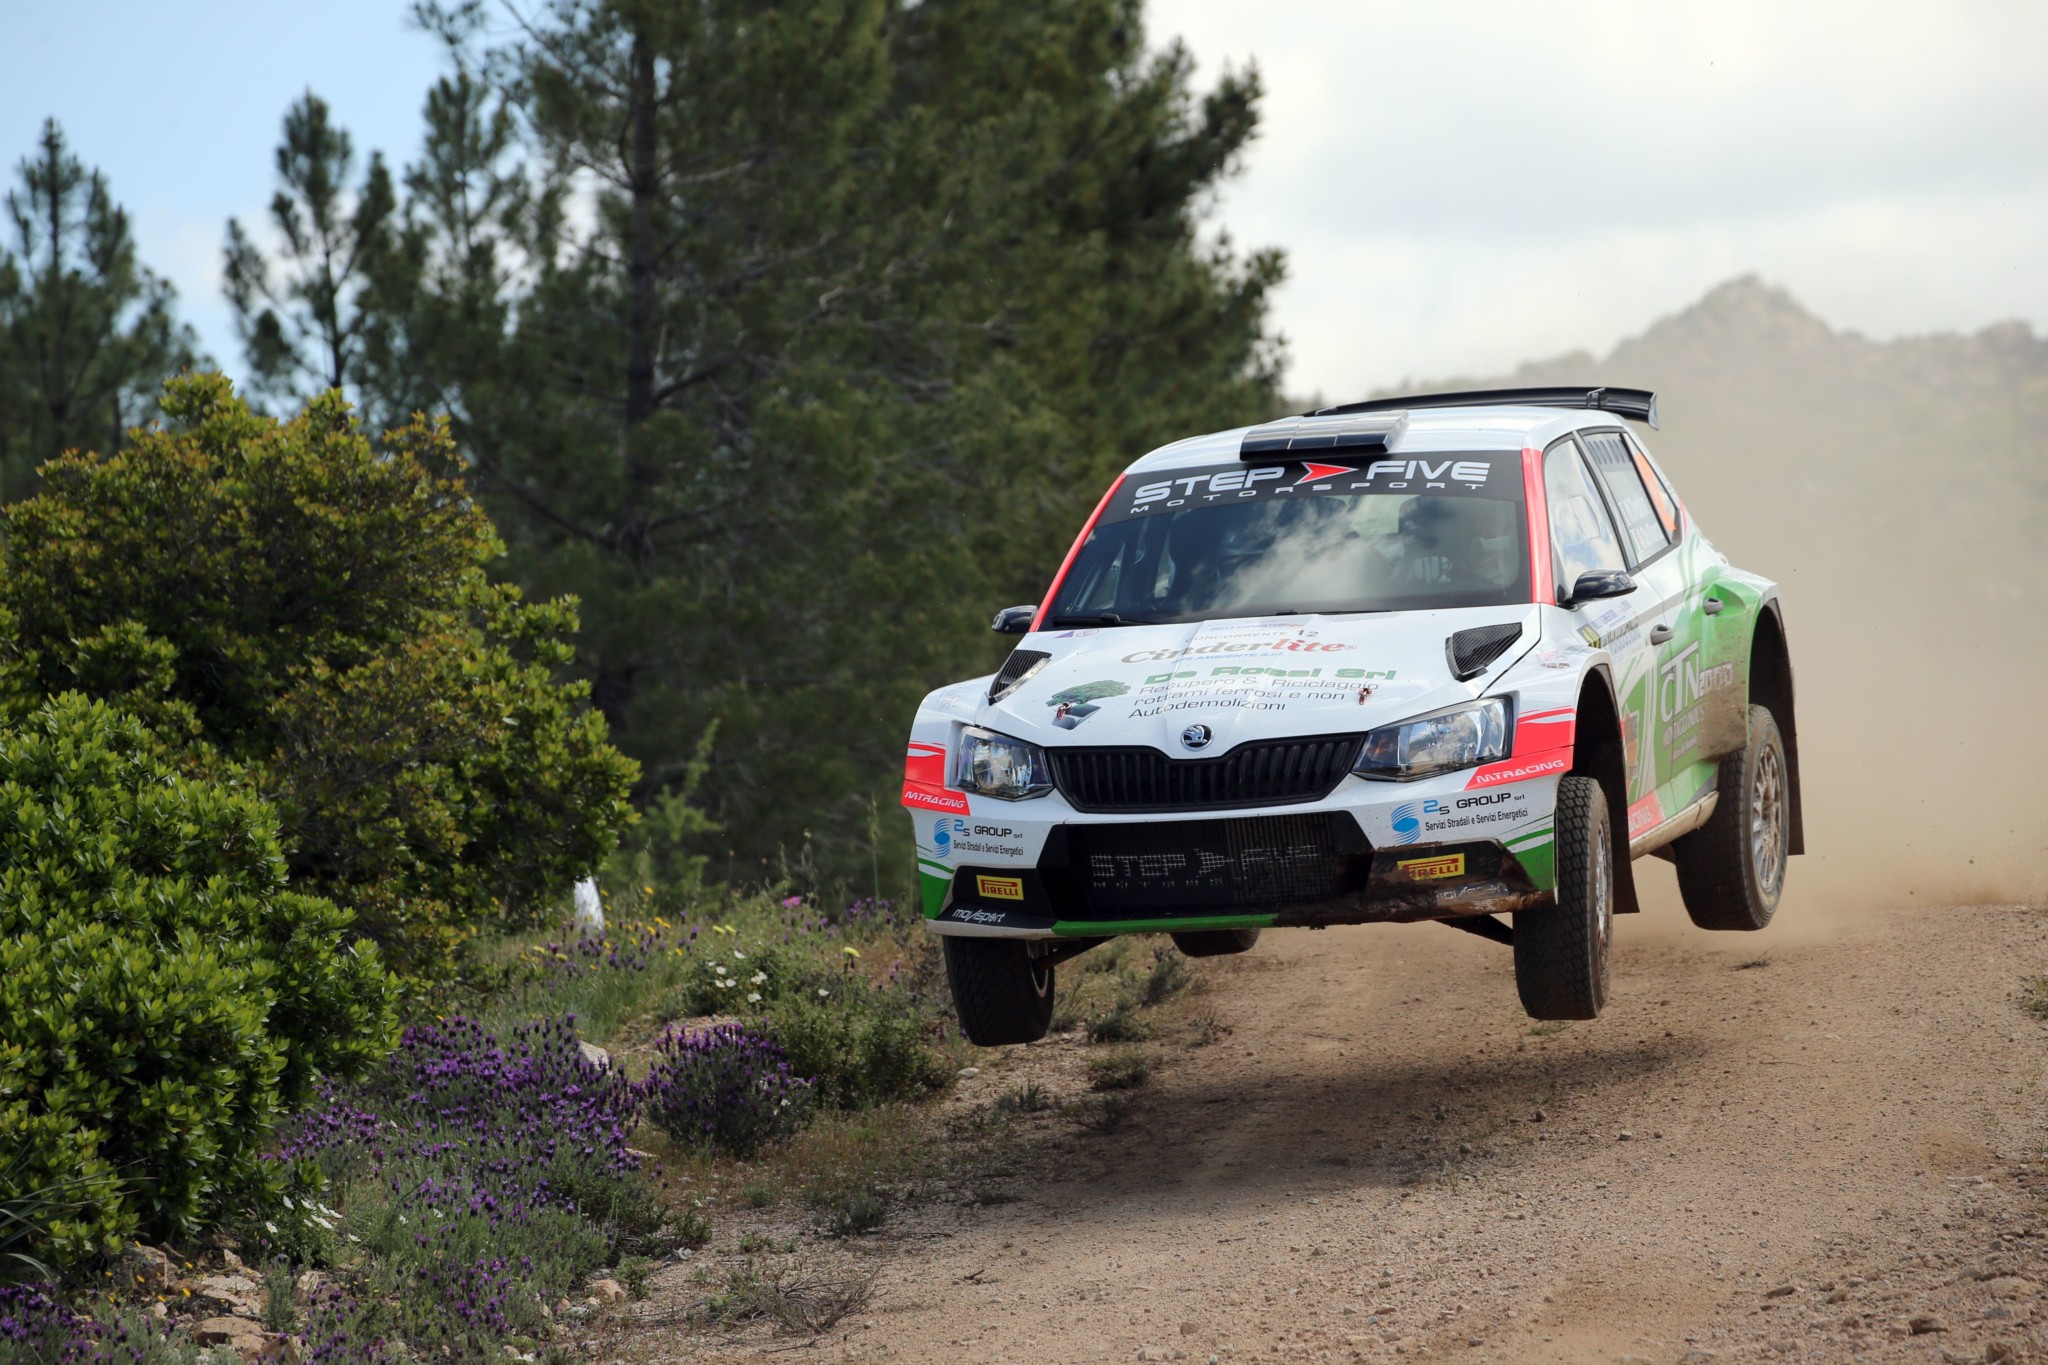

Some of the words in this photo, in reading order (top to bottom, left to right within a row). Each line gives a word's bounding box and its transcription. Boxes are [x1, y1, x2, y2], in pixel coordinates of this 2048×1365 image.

[1133, 467, 1285, 505] STEP
[1366, 460, 1490, 482] FIVE
[1130, 482, 1484, 513] MOTORSPORT
[1121, 639, 1345, 663] Cinderlite
[1140, 678, 1235, 695] Recupero
[1242, 677, 1258, 685] &
[1271, 679, 1379, 691] Riciclaggio
[1134, 689, 1207, 706] rottami
[1215, 687, 1281, 699] ferrosi
[1128, 698, 1286, 718] Autodemolizioni
[1476, 760, 1564, 784] MTRACING
[904, 791, 965, 808] MTRACING
[1456, 792, 1511, 809] GROUP
[1425, 820, 1446, 831] Servizi
[1447, 815, 1470, 828] Stradali
[1476, 812, 1496, 824] Servizi
[1497, 808, 1528, 820] Energetici
[974, 825, 1012, 837] GROUP
[953, 840, 966, 850] Servizi
[967, 841, 981, 852] Stradali
[985, 843, 999, 853] Servizi
[1000, 845, 1024, 857] Energetici
[980, 879, 1018, 896] PIRELLI
